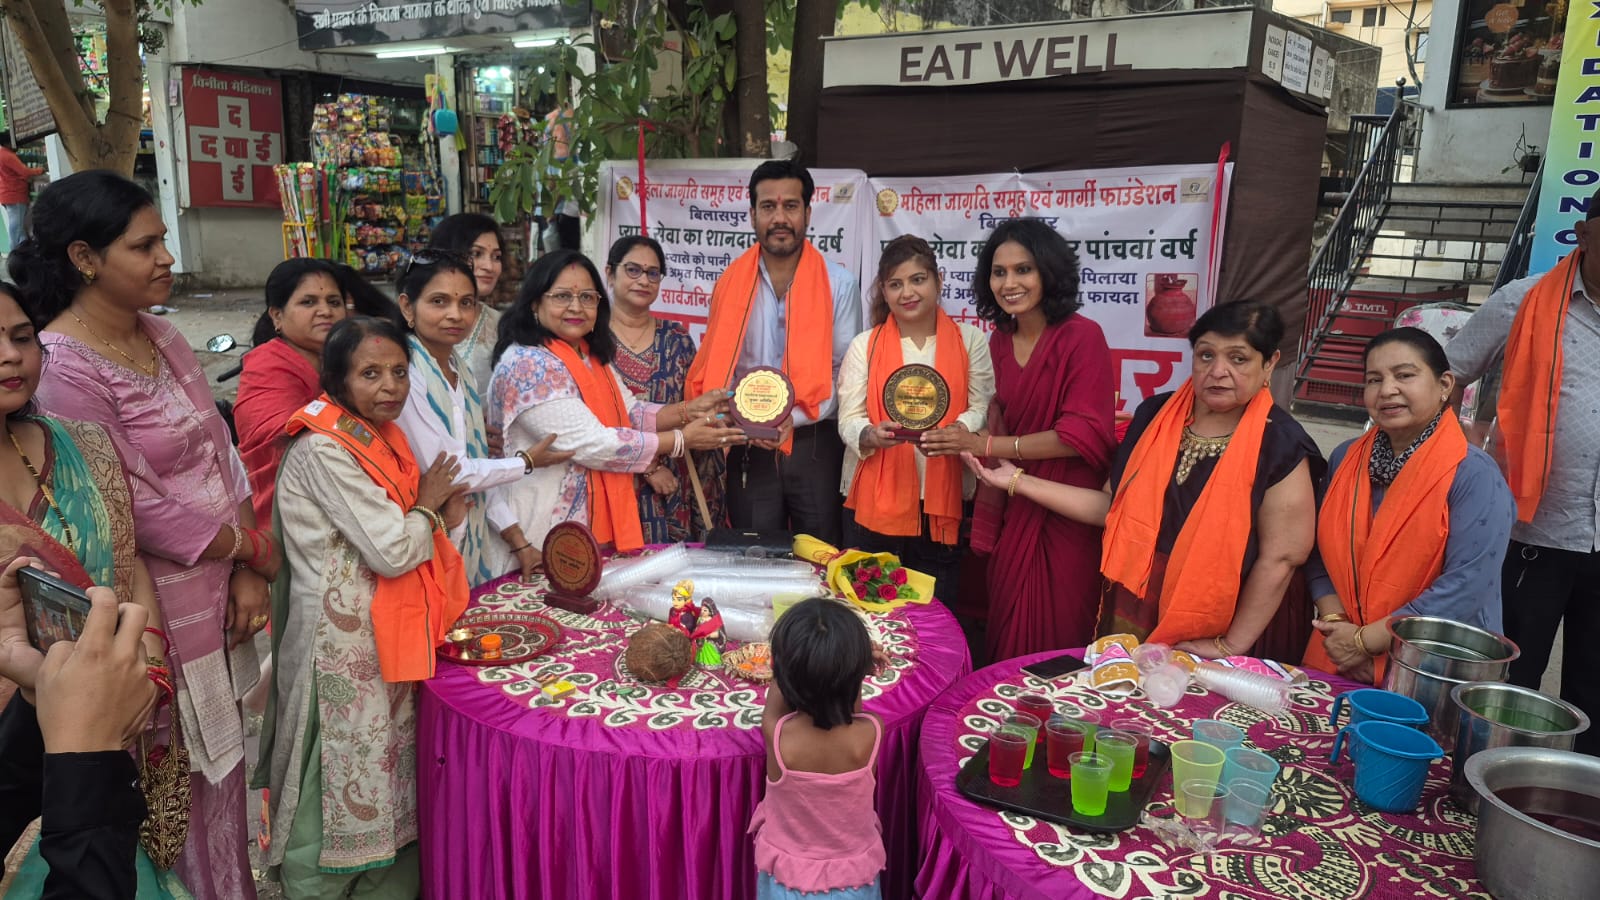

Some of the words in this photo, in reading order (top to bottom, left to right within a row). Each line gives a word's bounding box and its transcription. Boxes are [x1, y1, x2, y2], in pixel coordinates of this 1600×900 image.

[900, 41, 982, 82] EAT
[993, 32, 1132, 77] WELL
[231, 80, 273, 96] मेडिकल
[665, 177, 698, 206] जागृति
[701, 184, 725, 207] समूह
[727, 180, 743, 202] एवं
[901, 186, 942, 215] महिला
[944, 184, 990, 219] जागृति
[992, 190, 1027, 217] समूह
[1029, 182, 1054, 211] एवं
[1056, 179, 1097, 209] गार्गी
[1099, 177, 1177, 206] फाउंडेशन
[690, 205, 748, 227] बिलासपुर
[683, 229, 705, 245] का
[818, 227, 844, 253] वर्ष
[1085, 229, 1156, 260] पांचवां
[1160, 228, 1198, 260] वर्ष
[692, 251, 705, 265] को
[707, 253, 732, 267] पानी
[669, 267, 692, 283] अमृत
[1080, 267, 1138, 285] पिलाया
[1087, 291, 1140, 305] फायदा
